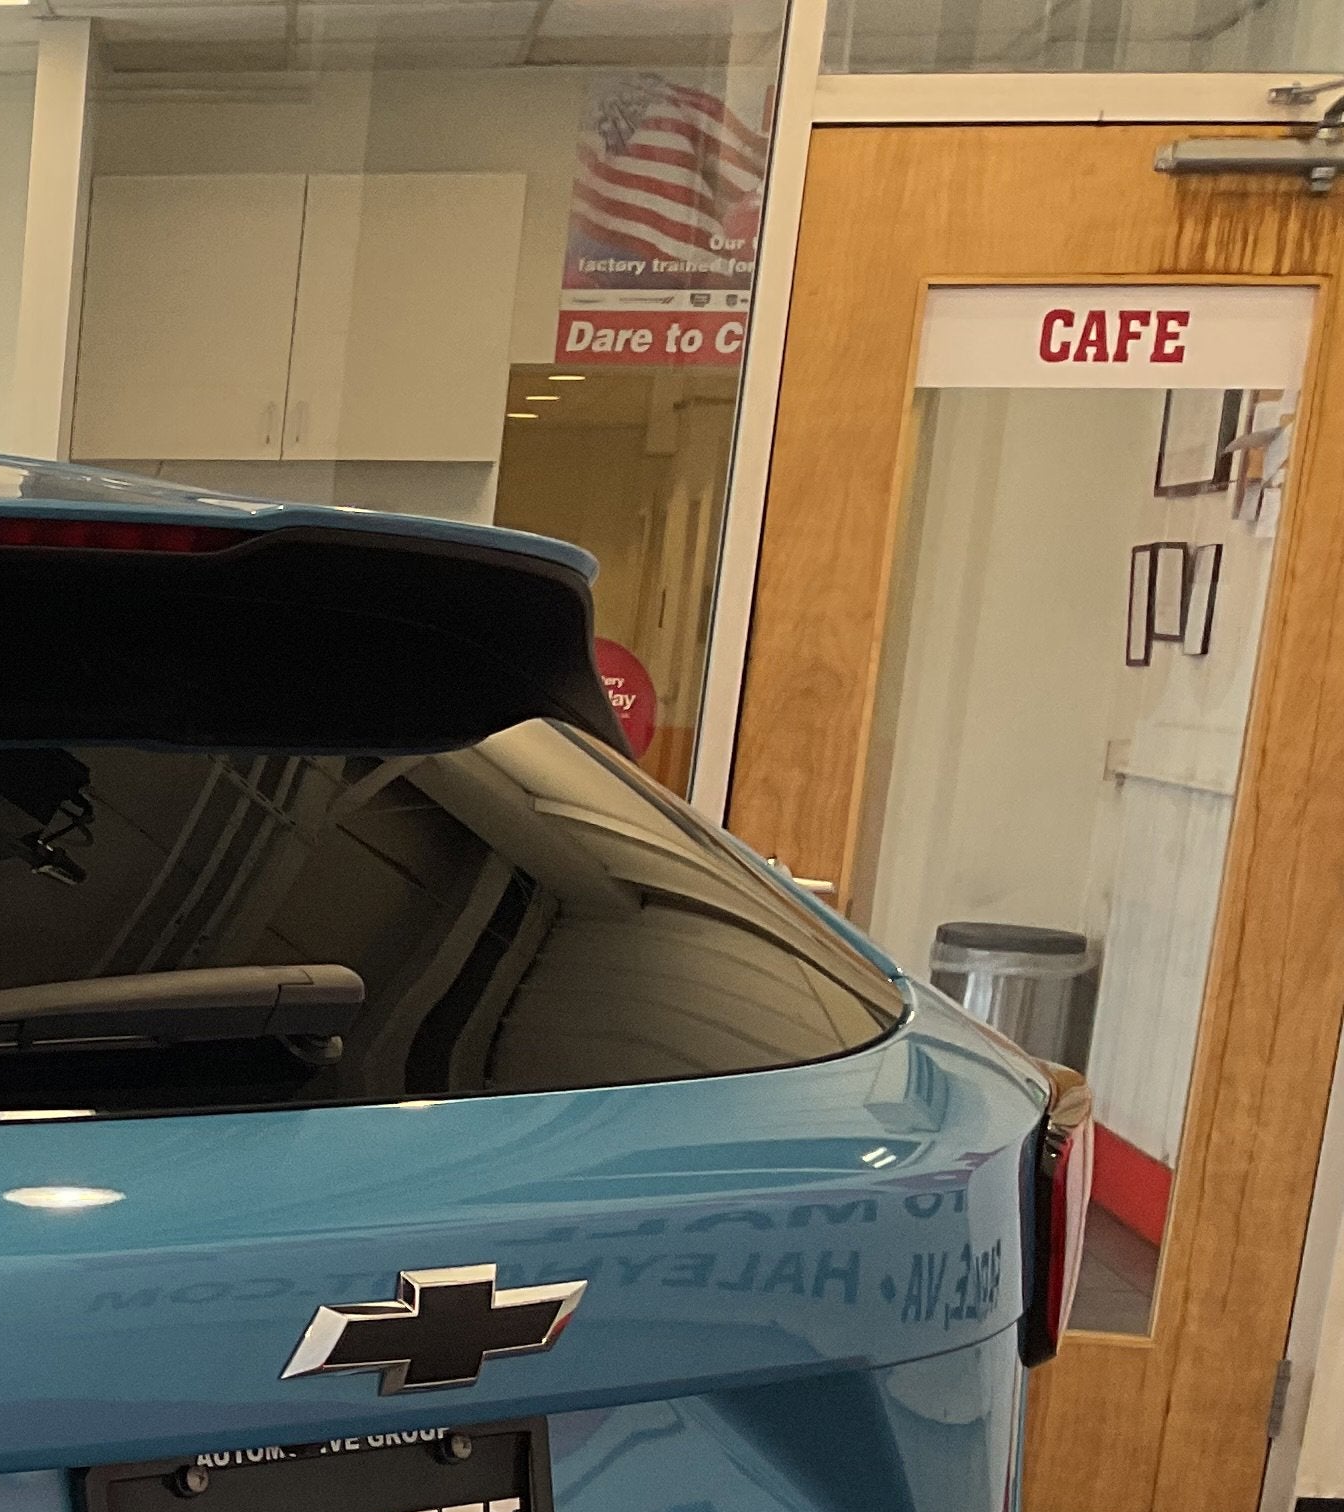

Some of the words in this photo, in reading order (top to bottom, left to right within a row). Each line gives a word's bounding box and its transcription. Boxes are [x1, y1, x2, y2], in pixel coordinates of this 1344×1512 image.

[710, 234, 745, 250] Our
[578, 257, 646, 275] factory
[652, 257, 721, 273] trained
[566, 320, 653, 352] Dare
[666, 323, 703, 353] to
[1039, 308, 1190, 363] CAFE
